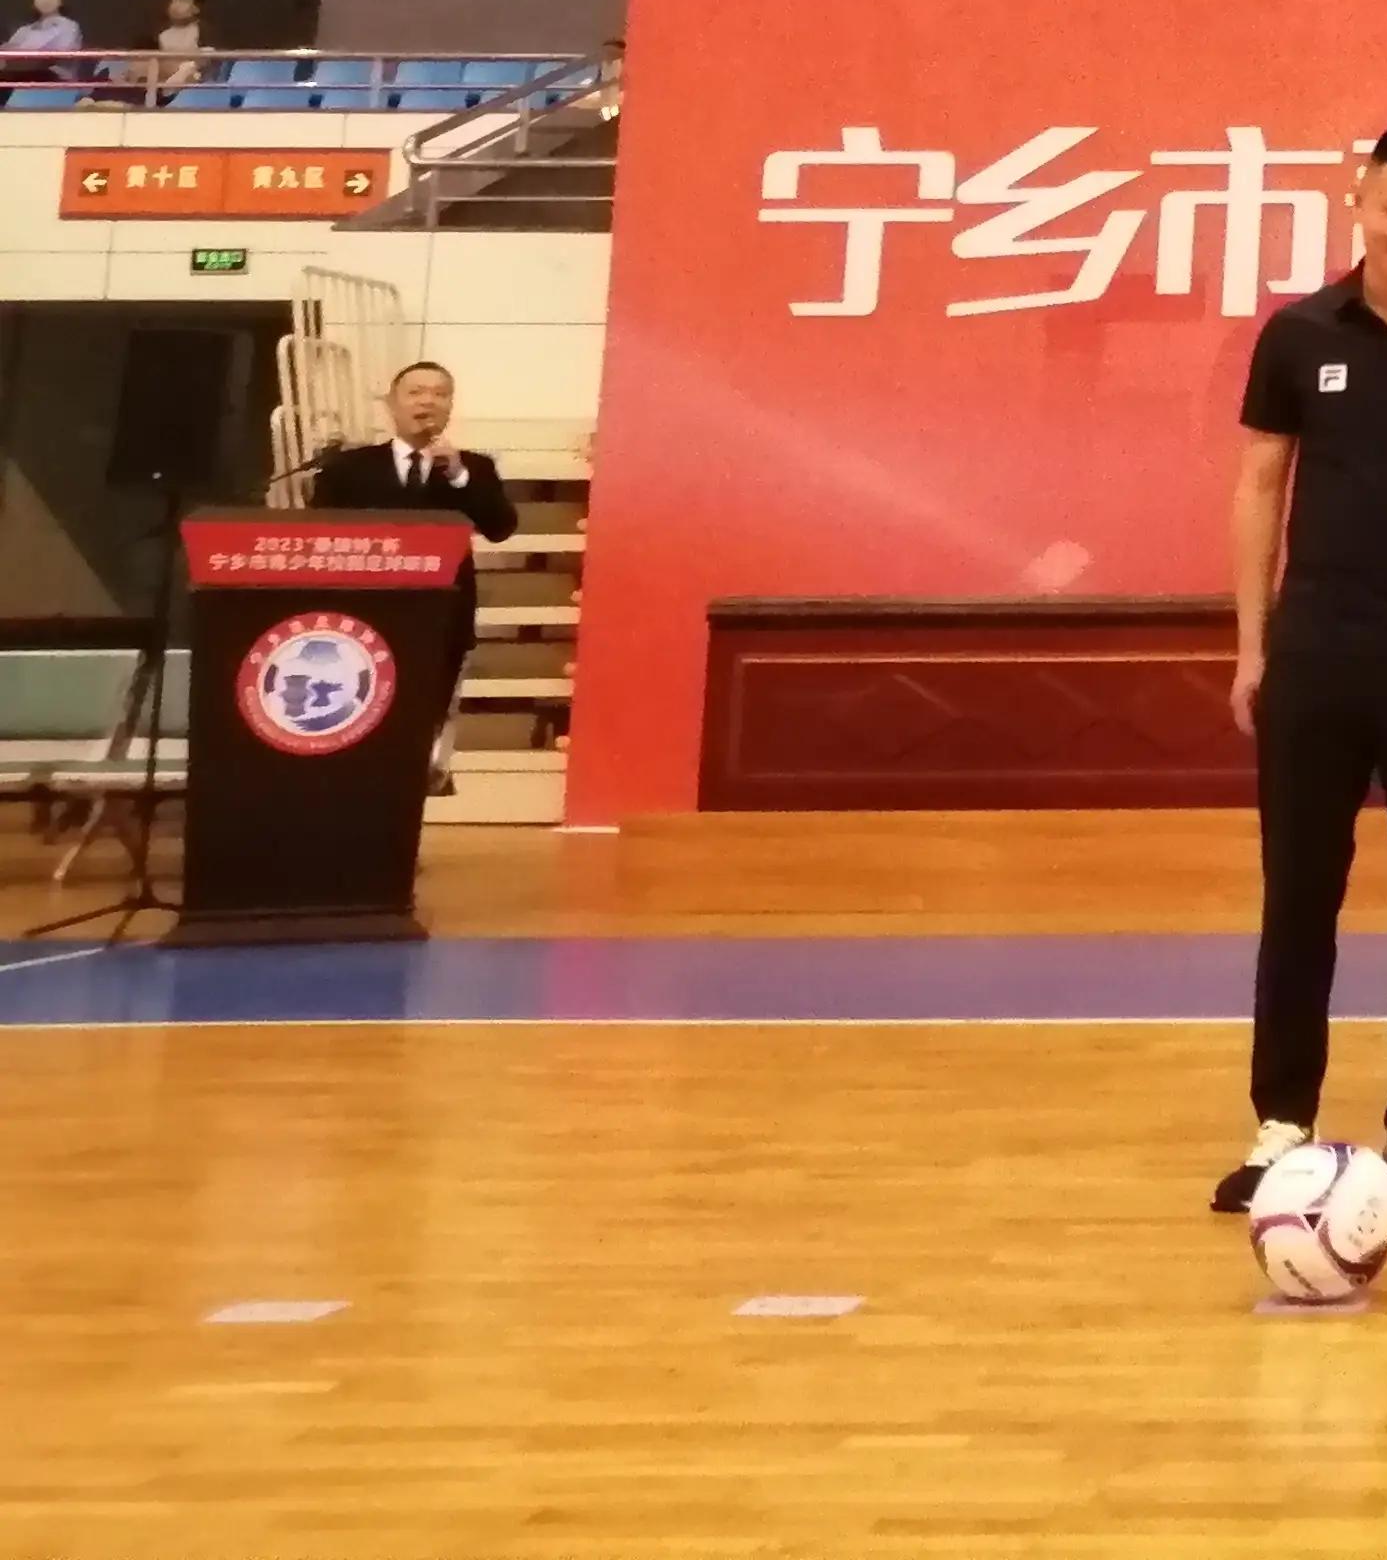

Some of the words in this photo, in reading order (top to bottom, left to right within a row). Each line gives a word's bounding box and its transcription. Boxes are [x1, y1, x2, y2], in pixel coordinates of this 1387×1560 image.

[126, 164, 199, 189] 黄十区
[252, 165, 325, 189] 黄九区
